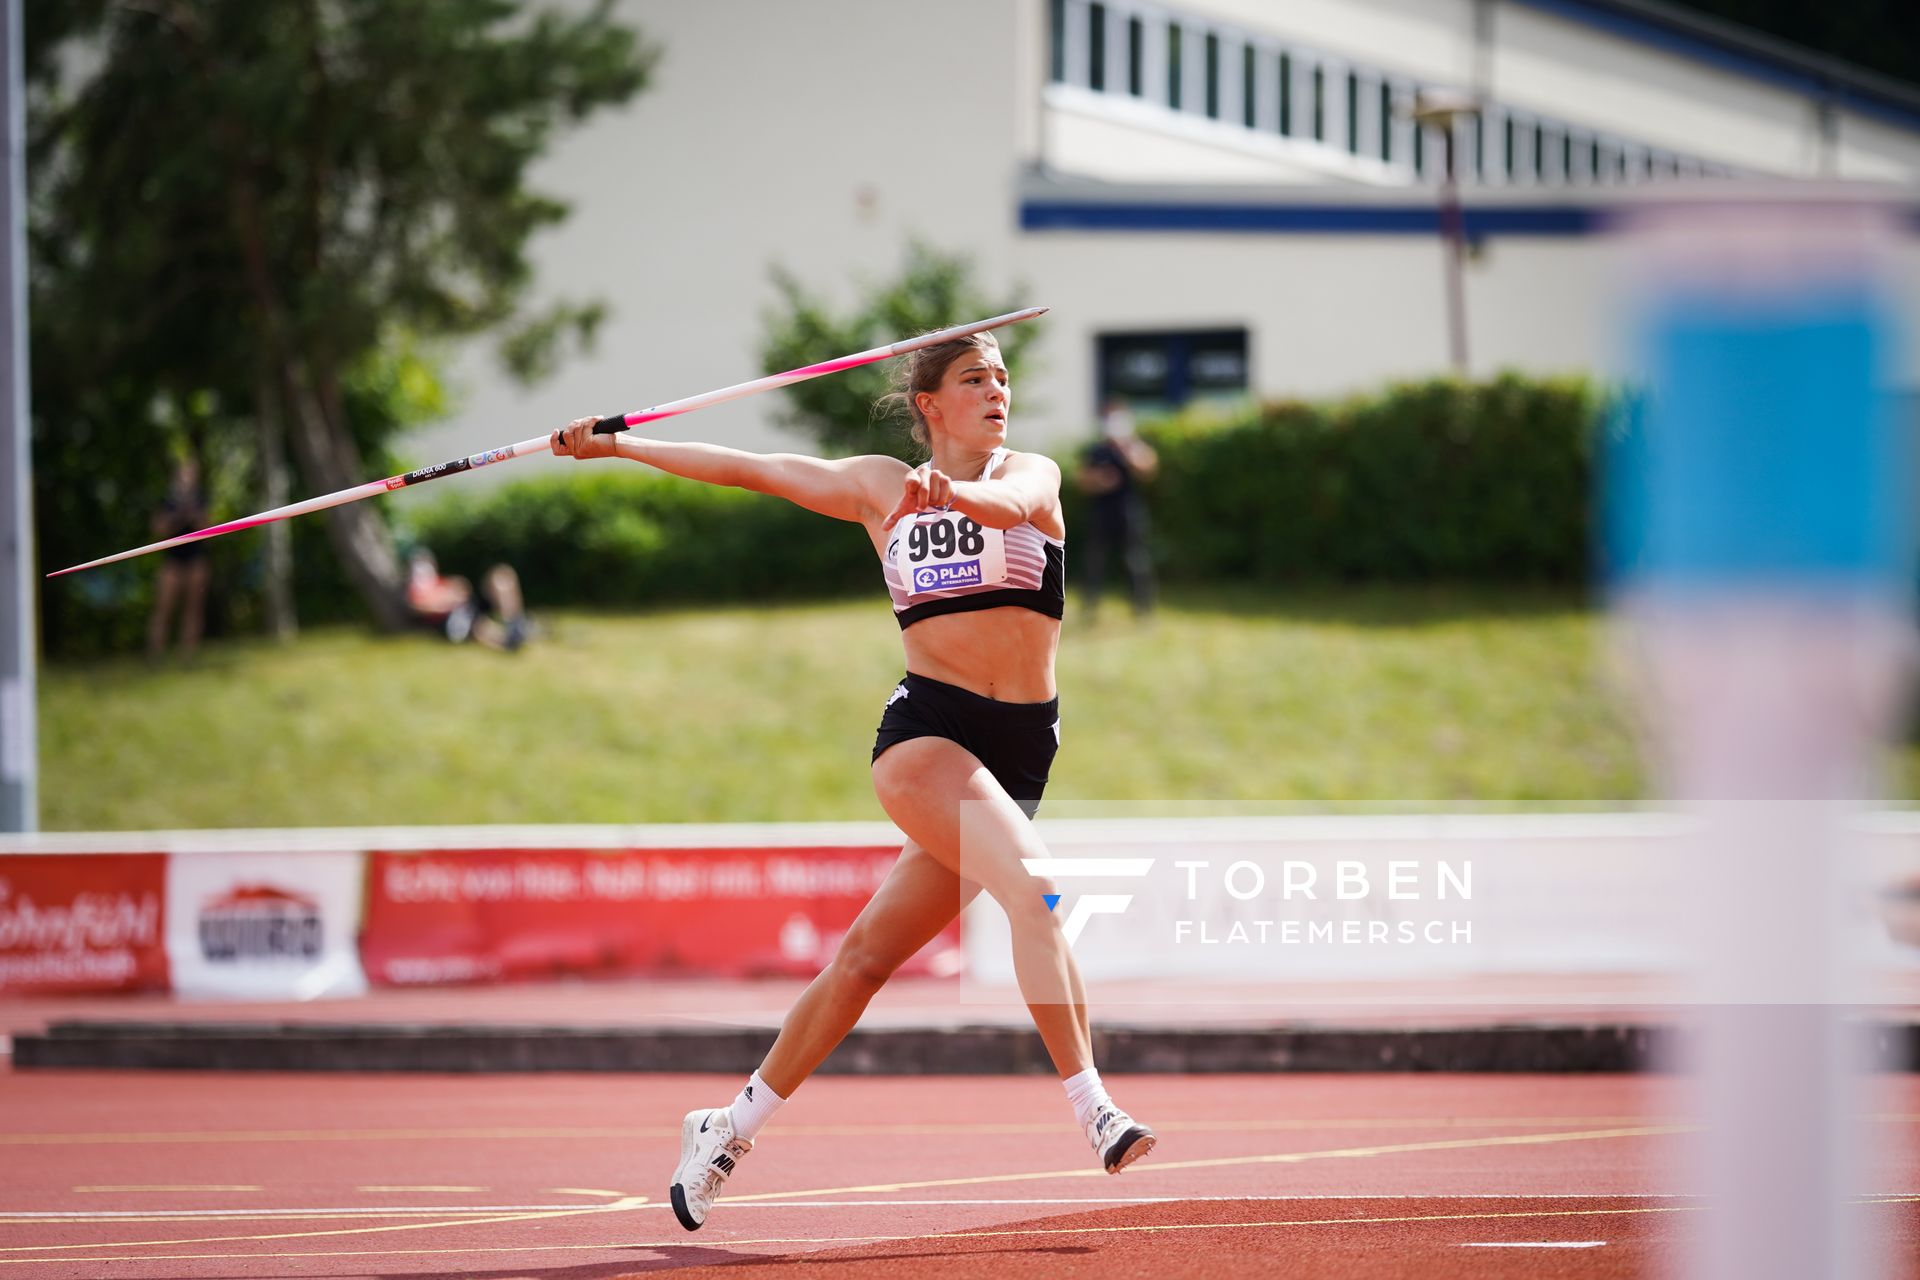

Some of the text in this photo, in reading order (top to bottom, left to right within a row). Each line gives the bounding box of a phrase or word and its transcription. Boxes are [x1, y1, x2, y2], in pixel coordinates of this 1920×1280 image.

[412, 466, 434, 478] DIANA
[434, 462, 447, 472] 600
[908, 516, 985, 562] 998
[940, 564, 979, 580] PLAN
[941, 577, 979, 585] INTERNATIONAL
